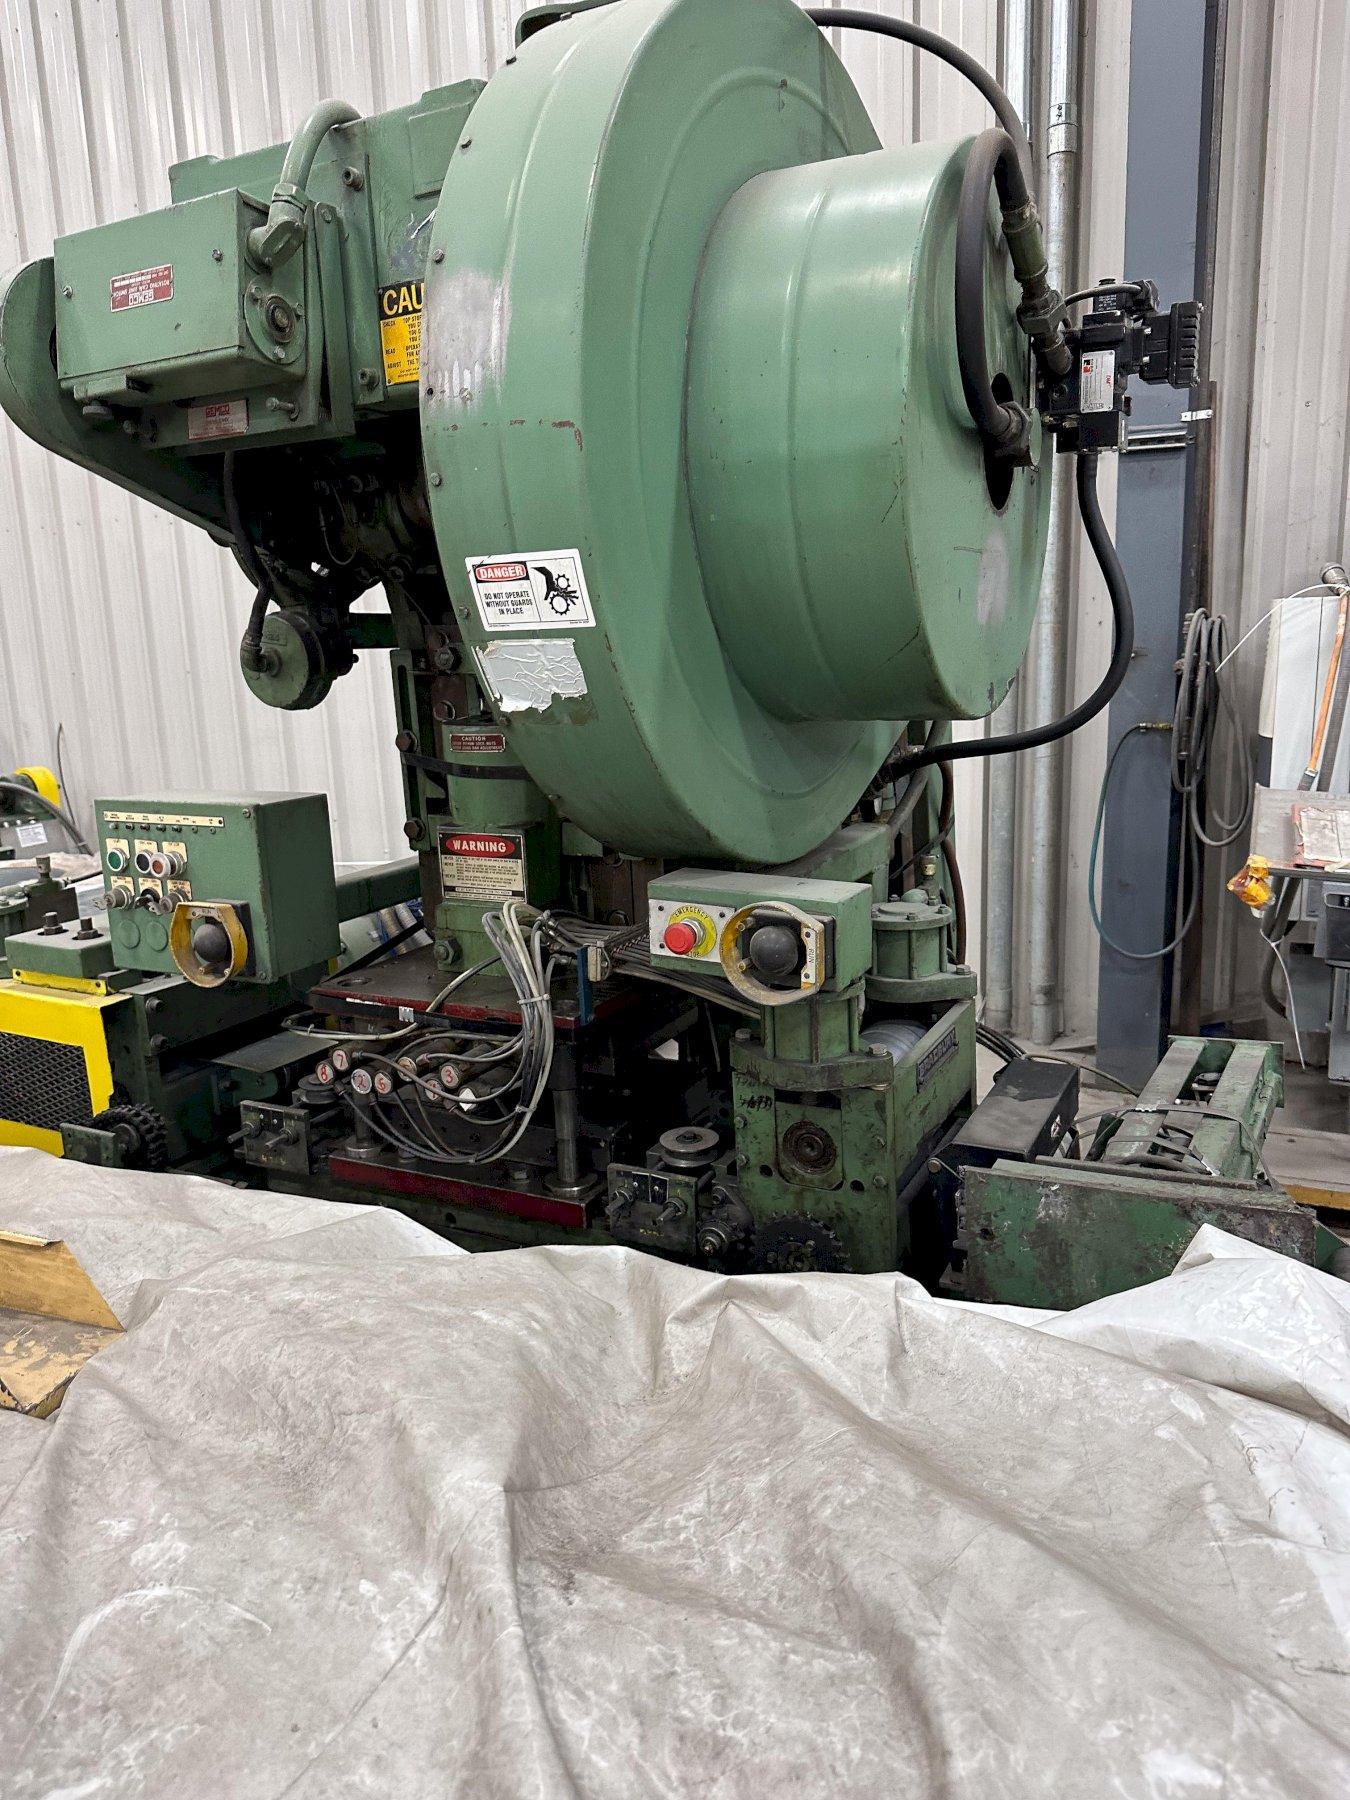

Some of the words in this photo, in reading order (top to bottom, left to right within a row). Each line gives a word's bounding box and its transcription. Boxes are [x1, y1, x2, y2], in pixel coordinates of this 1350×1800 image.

[129, 289, 154, 306] GEMCO
[480, 566, 524, 580] DANGER
[493, 592, 504, 600] NOT
[505, 590, 530, 599] OPERATE
[485, 599, 510, 608] WITHOUT
[510, 598, 533, 607] GUARDS
[453, 840, 506, 852] WARNING
[674, 906, 709, 919] EMERGENCY
[337, 1054, 344, 1067] 7
[320, 1065, 328, 1081] 8
[445, 1069, 453, 1084] 3
